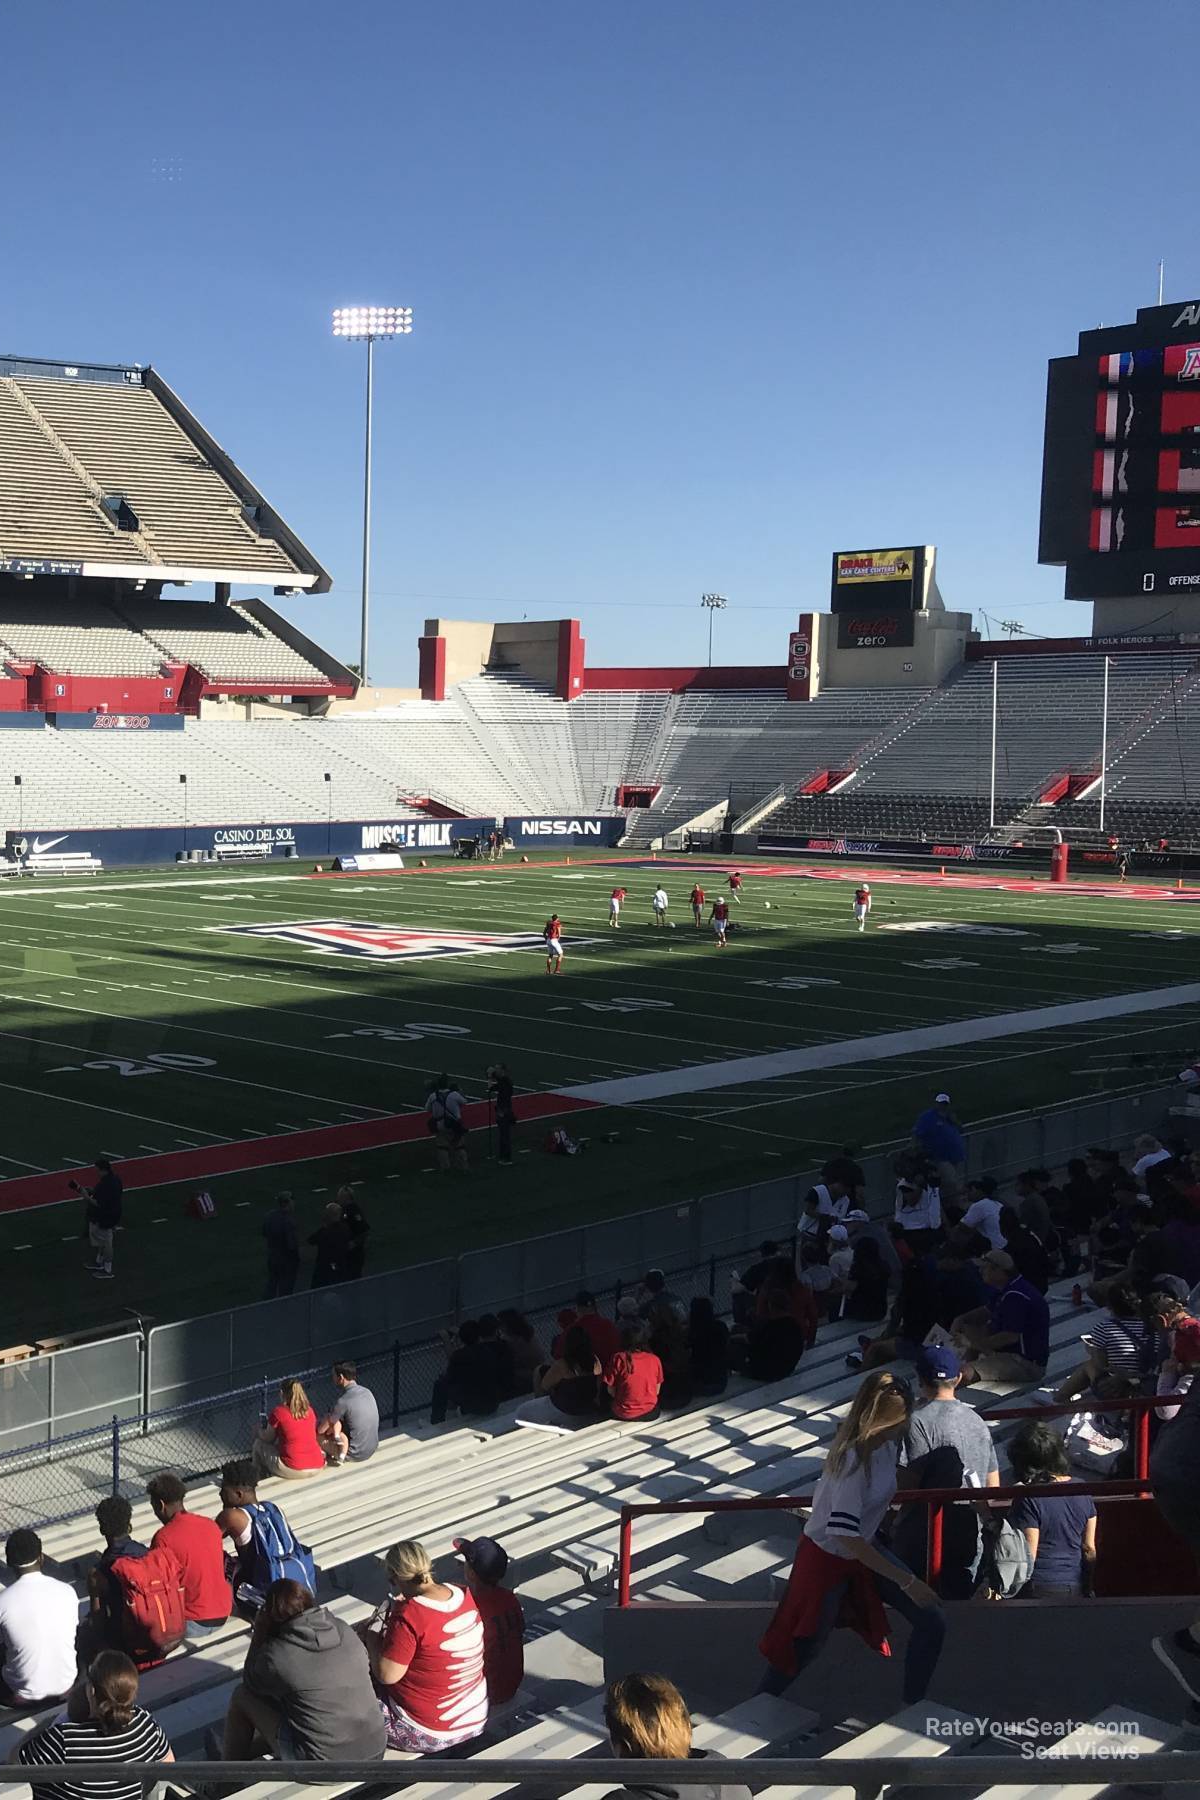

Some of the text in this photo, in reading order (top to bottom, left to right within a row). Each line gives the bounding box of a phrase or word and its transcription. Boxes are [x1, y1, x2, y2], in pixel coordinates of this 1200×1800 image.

[857, 635, 887, 646] zero
[418, 824, 452, 846] MILK
[521, 820, 601, 835] NISSAN
[214, 828, 295, 843] CASINO DEL SOL
[82, 1051, 218, 1077] 20
